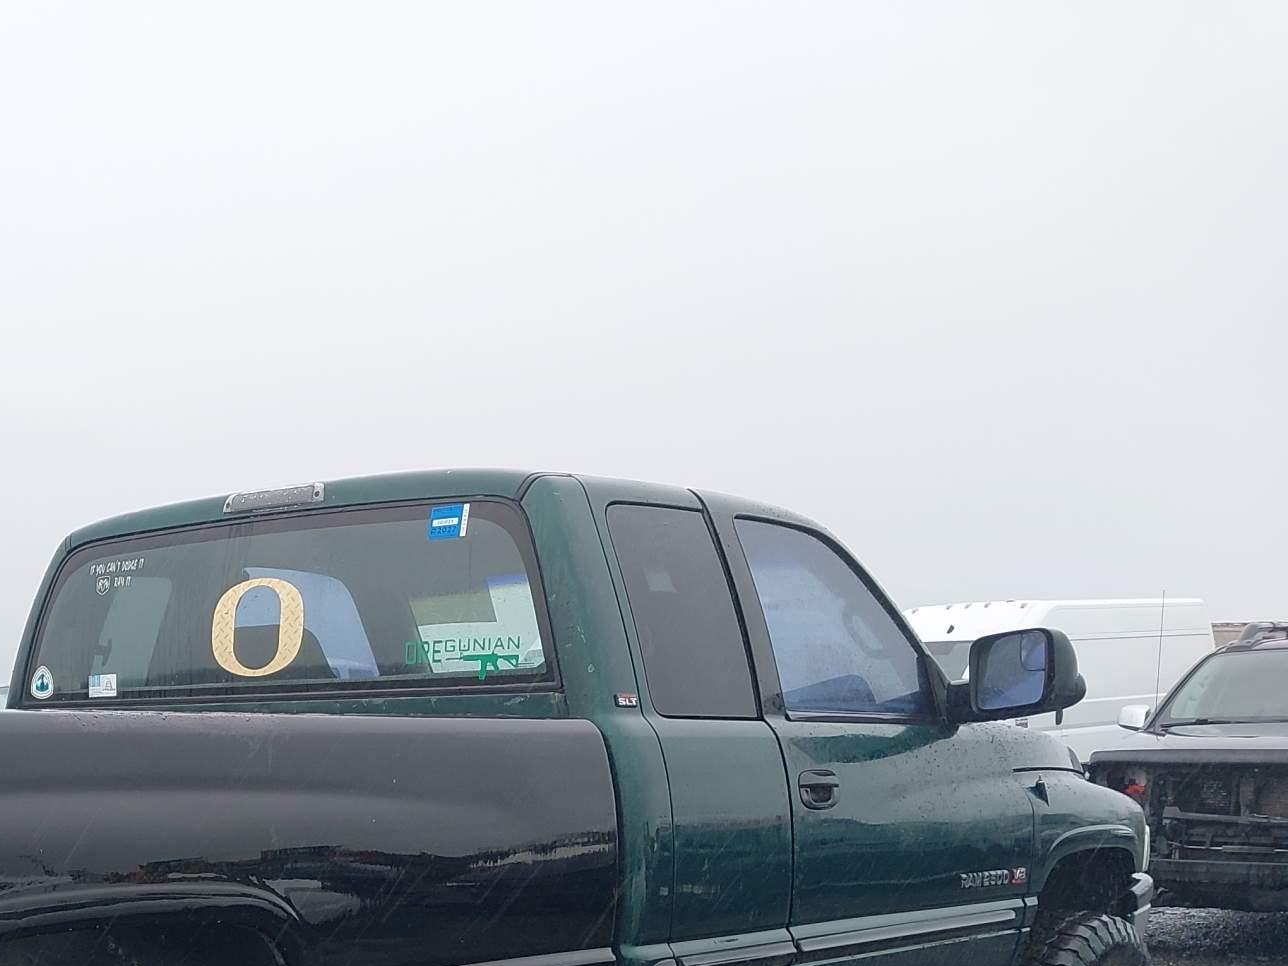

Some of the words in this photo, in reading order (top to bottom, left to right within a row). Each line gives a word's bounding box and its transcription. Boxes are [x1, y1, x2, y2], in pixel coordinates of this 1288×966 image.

[211, 577, 305, 677] O
[405, 636, 521, 665] OREGUNIAN
[618, 697, 638, 706] SLT
[959, 872, 982, 889] RAM
